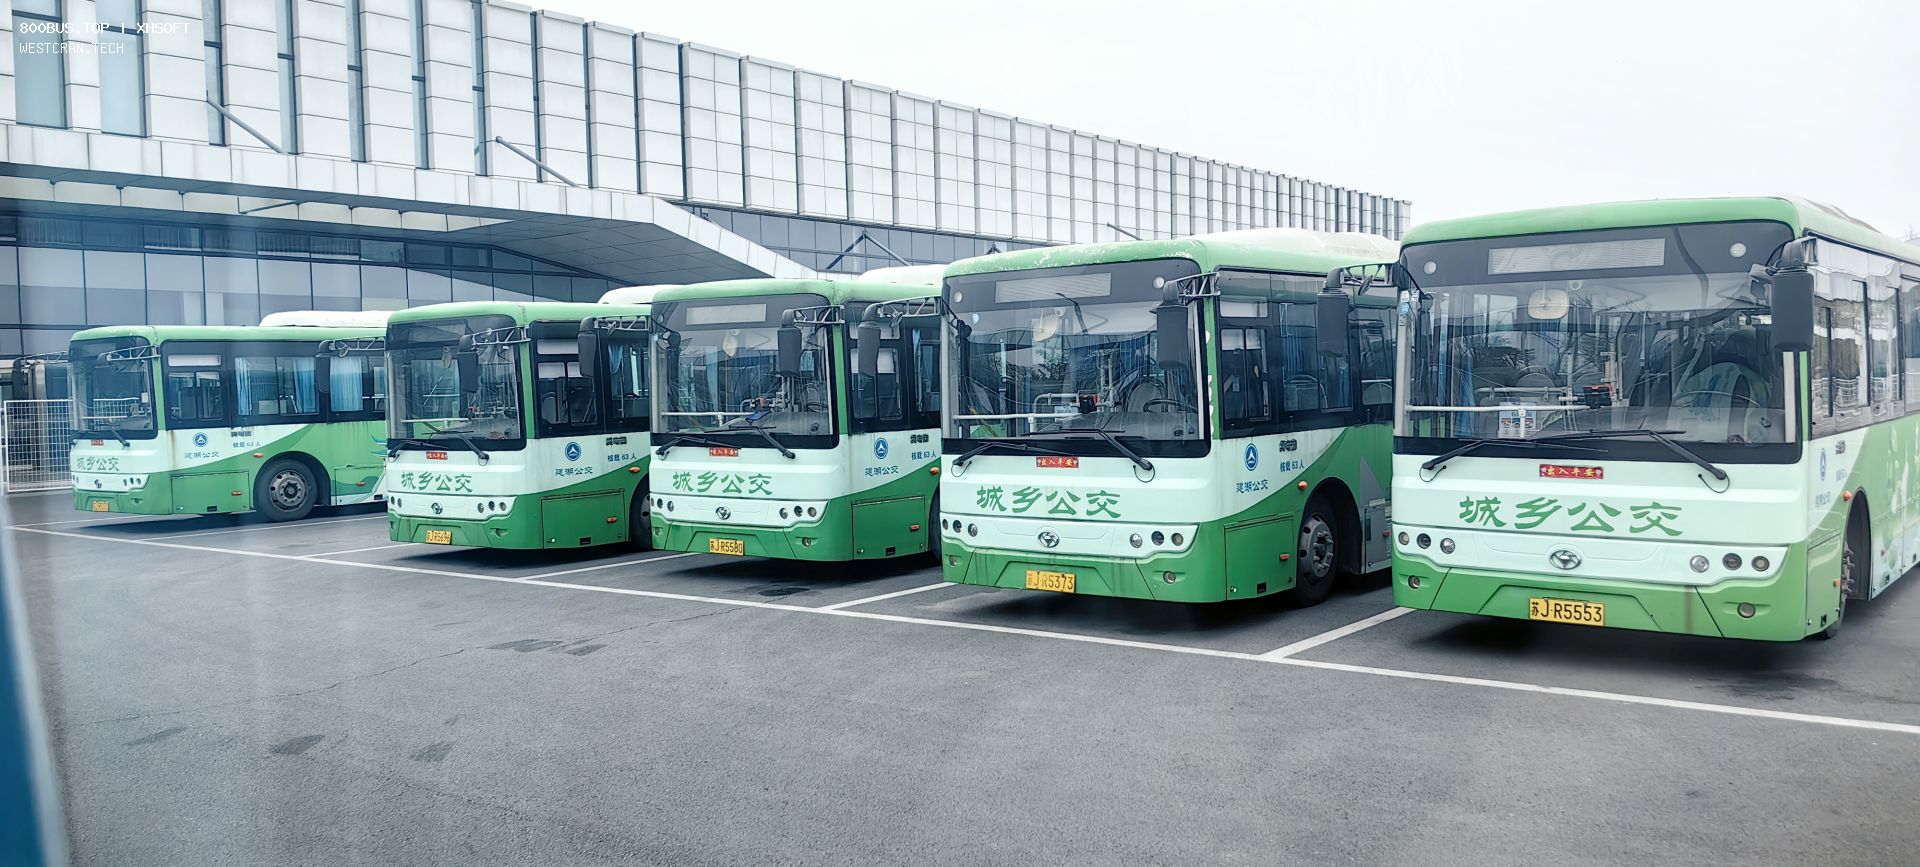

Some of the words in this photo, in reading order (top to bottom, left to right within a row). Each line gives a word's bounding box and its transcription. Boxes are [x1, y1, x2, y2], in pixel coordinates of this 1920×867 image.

[401, 471, 473, 493] 城乡公交
[672, 471, 773, 495] 城乡公交
[1547, 465, 1595, 477] 出入平安
[977, 485, 1121, 518] 城乡公交
[1459, 496, 1683, 537] 城乡公交
